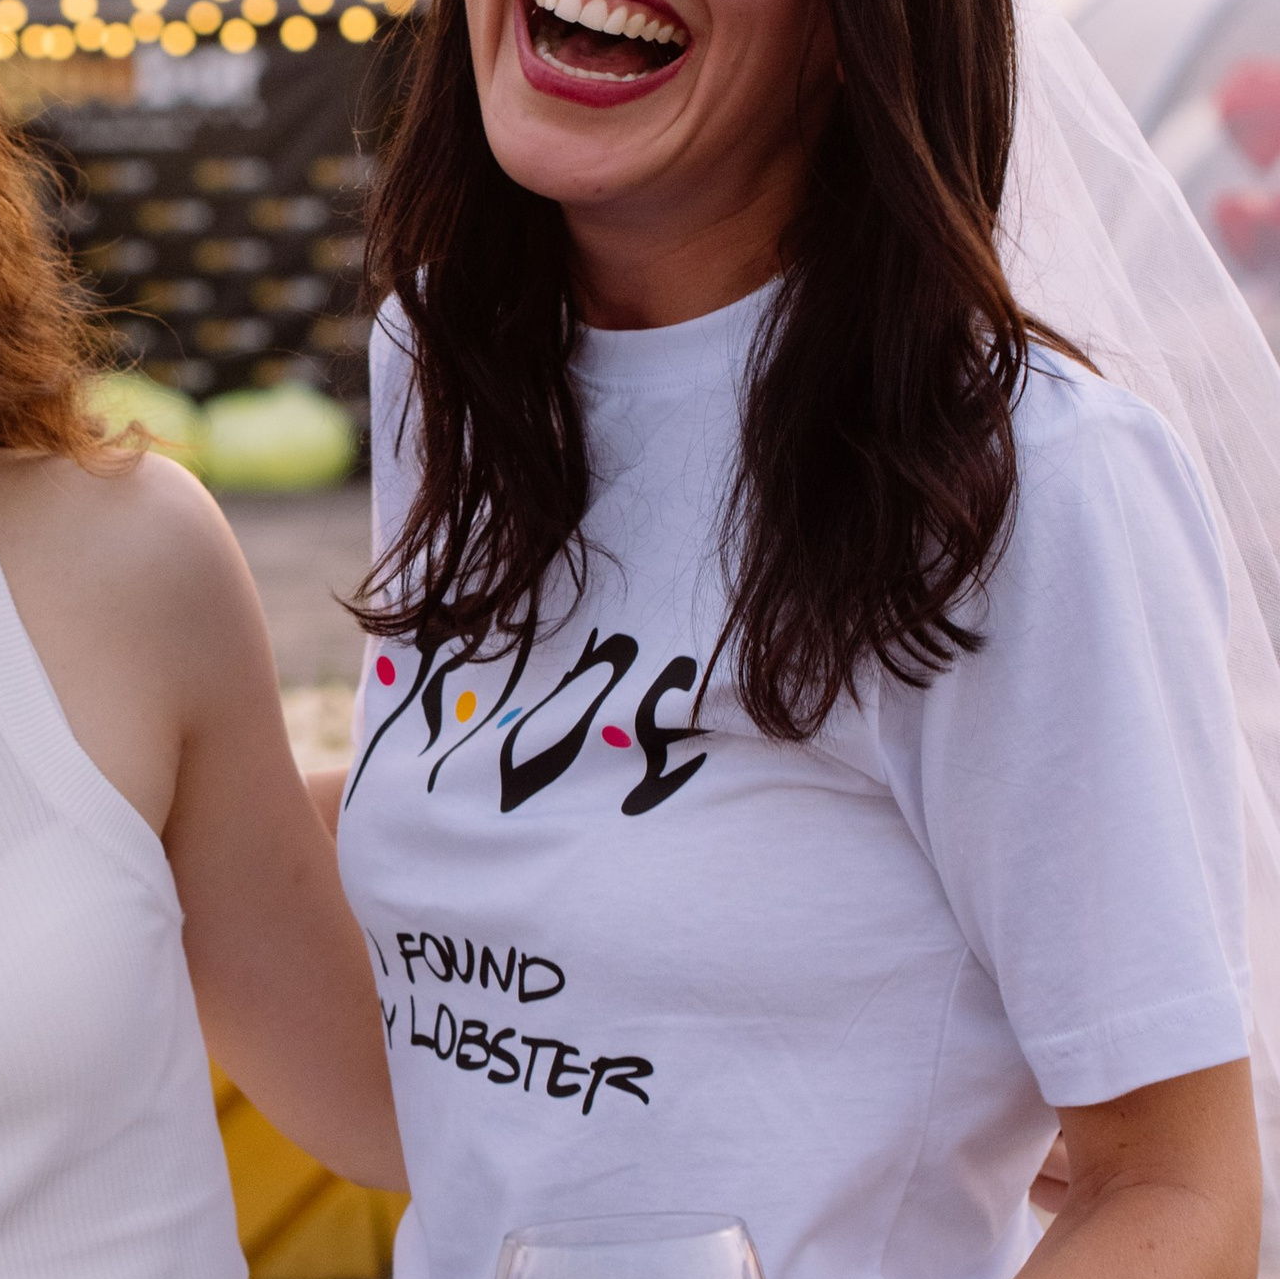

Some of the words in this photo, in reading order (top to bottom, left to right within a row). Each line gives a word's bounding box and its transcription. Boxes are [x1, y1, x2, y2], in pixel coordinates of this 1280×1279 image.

[344, 592, 716, 816] RIDE
[366, 927, 389, 976] I
[396, 930, 566, 1003] FOUND
[380, 997, 397, 1050] Y
[409, 994, 654, 1116] LOBSTER
